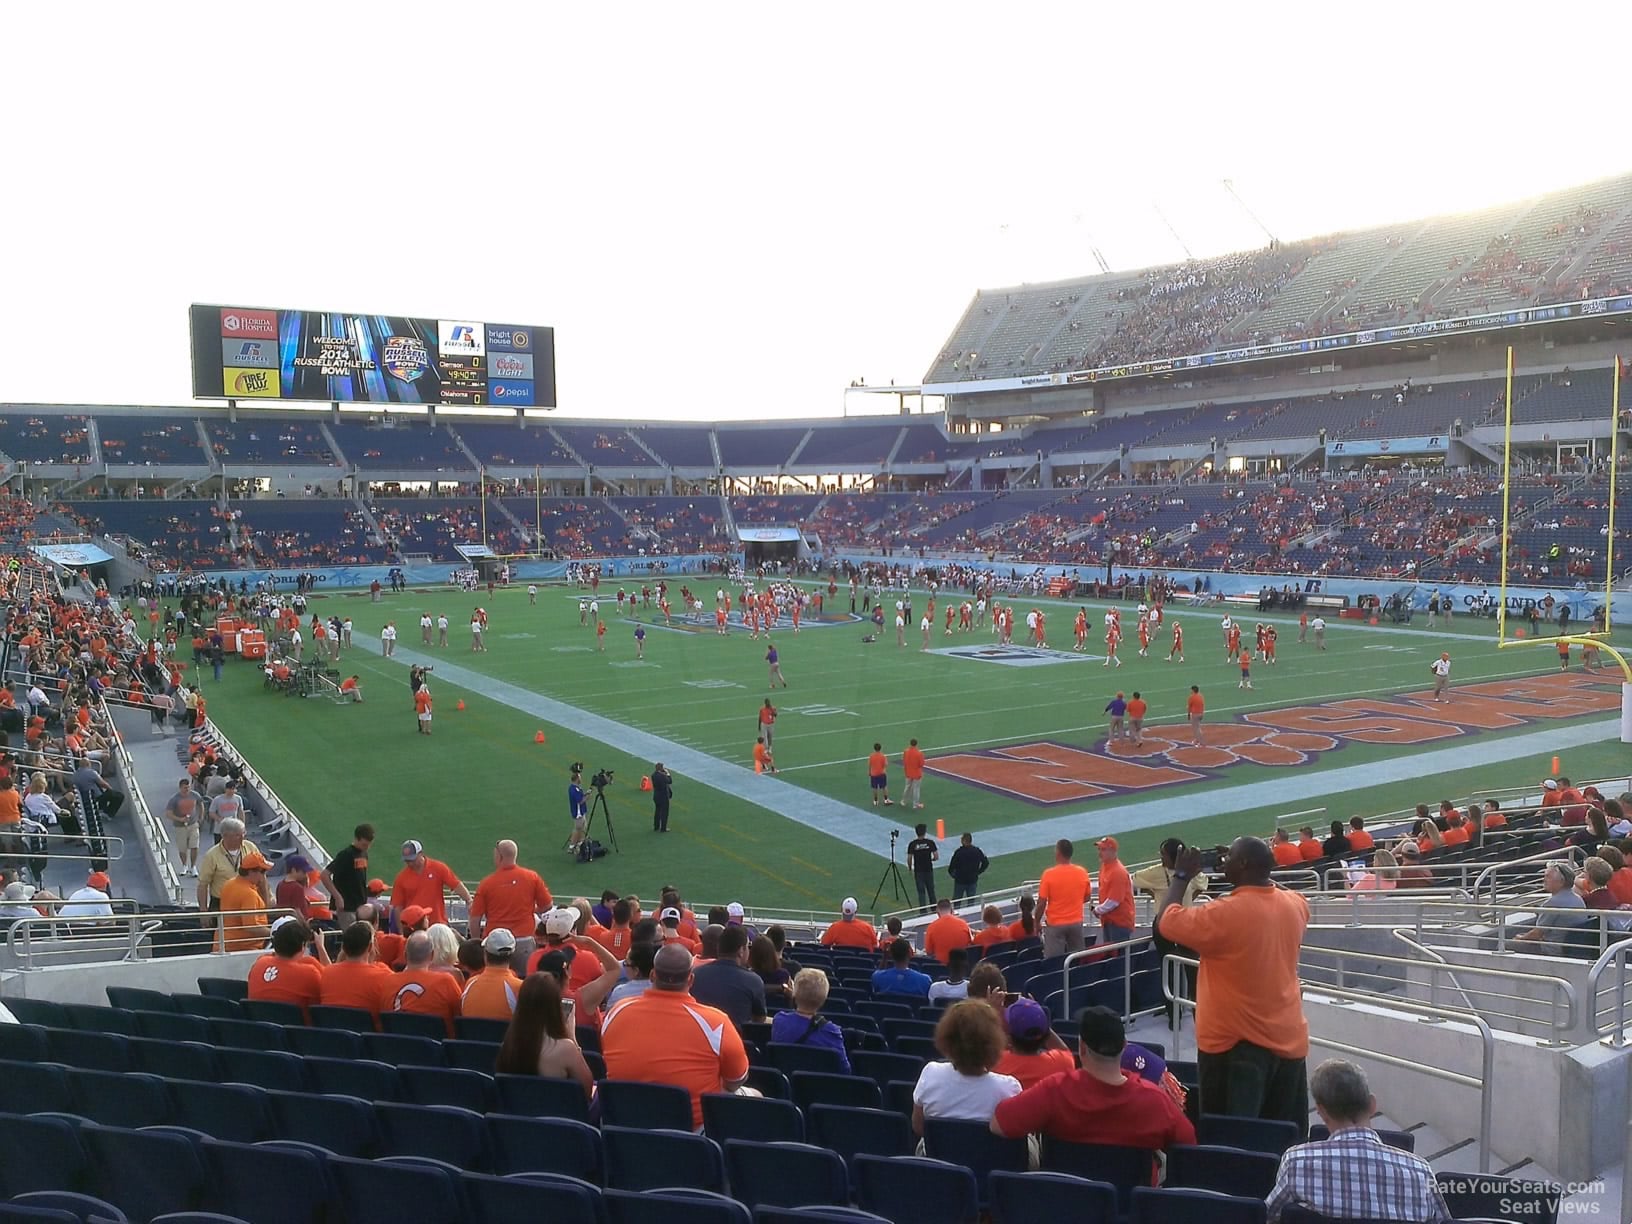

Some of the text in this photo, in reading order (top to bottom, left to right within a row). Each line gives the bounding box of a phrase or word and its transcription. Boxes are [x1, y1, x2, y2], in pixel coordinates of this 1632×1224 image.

[242, 316, 271, 325] FLORIDA
[242, 323, 273, 332] HOSPITAL
[488, 329, 511, 339] bright
[313, 336, 357, 345] WELCOME
[489, 337, 511, 345] house
[319, 349, 350, 360] 2014
[294, 357, 376, 369] RUSSELL ATHLETIC
[439, 361, 464, 369] Clemson
[472, 357, 480, 367] 0
[496, 358, 525, 370] Coors
[320, 366, 351, 376] BOWL
[448, 370, 470, 380] 49:40
[497, 369, 523, 377] LIGHT
[243, 371, 267, 383] TIRES
[246, 380, 268, 392] PLUS
[440, 390, 469, 398] Oklahoma
[506, 387, 529, 398] pepsi
[474, 394, 481, 404] 0
[269, 574, 327, 584] ORLDO
